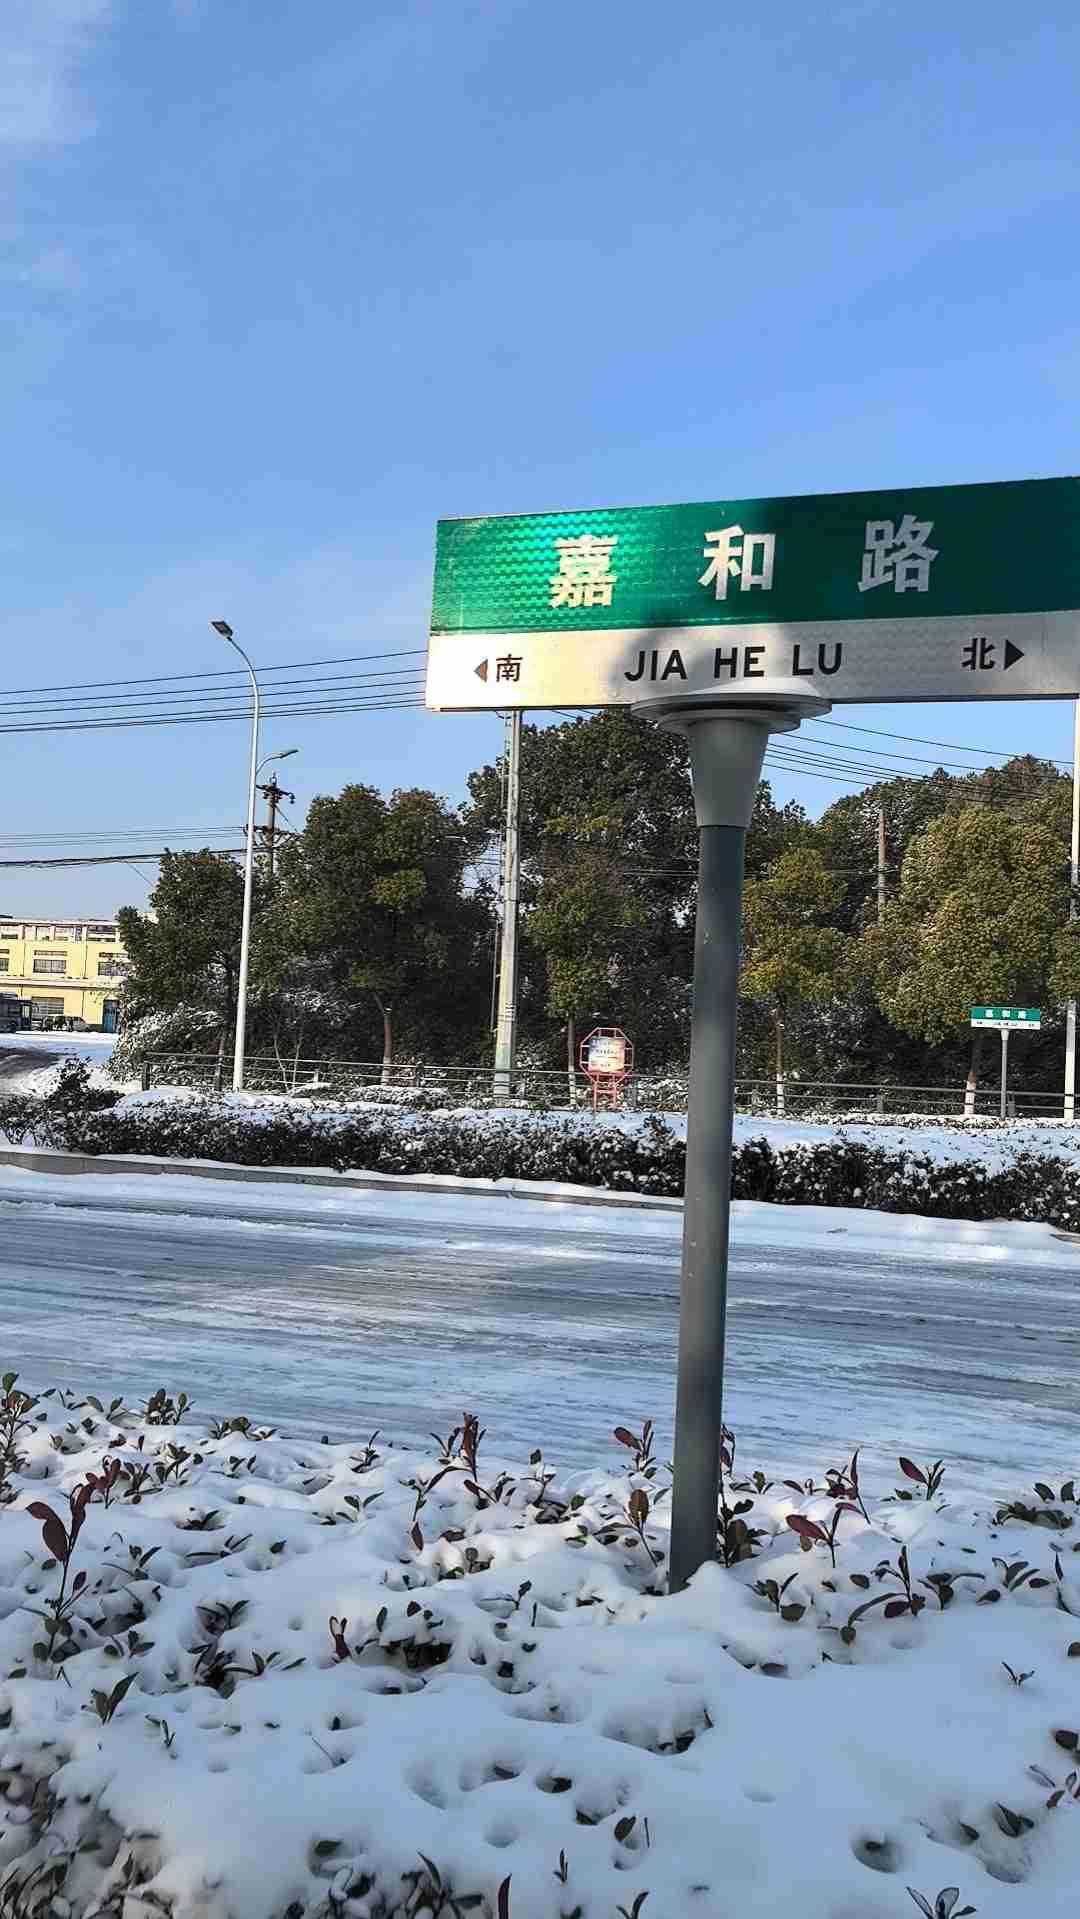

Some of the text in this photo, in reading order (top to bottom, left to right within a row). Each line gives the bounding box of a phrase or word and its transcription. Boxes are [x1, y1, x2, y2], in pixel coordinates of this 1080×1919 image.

[549, 514, 939, 607] 嘉和路
[495, 653, 522, 682] 南
[625, 642, 843, 682] JIA HE LU
[961, 637, 995, 671] 北
